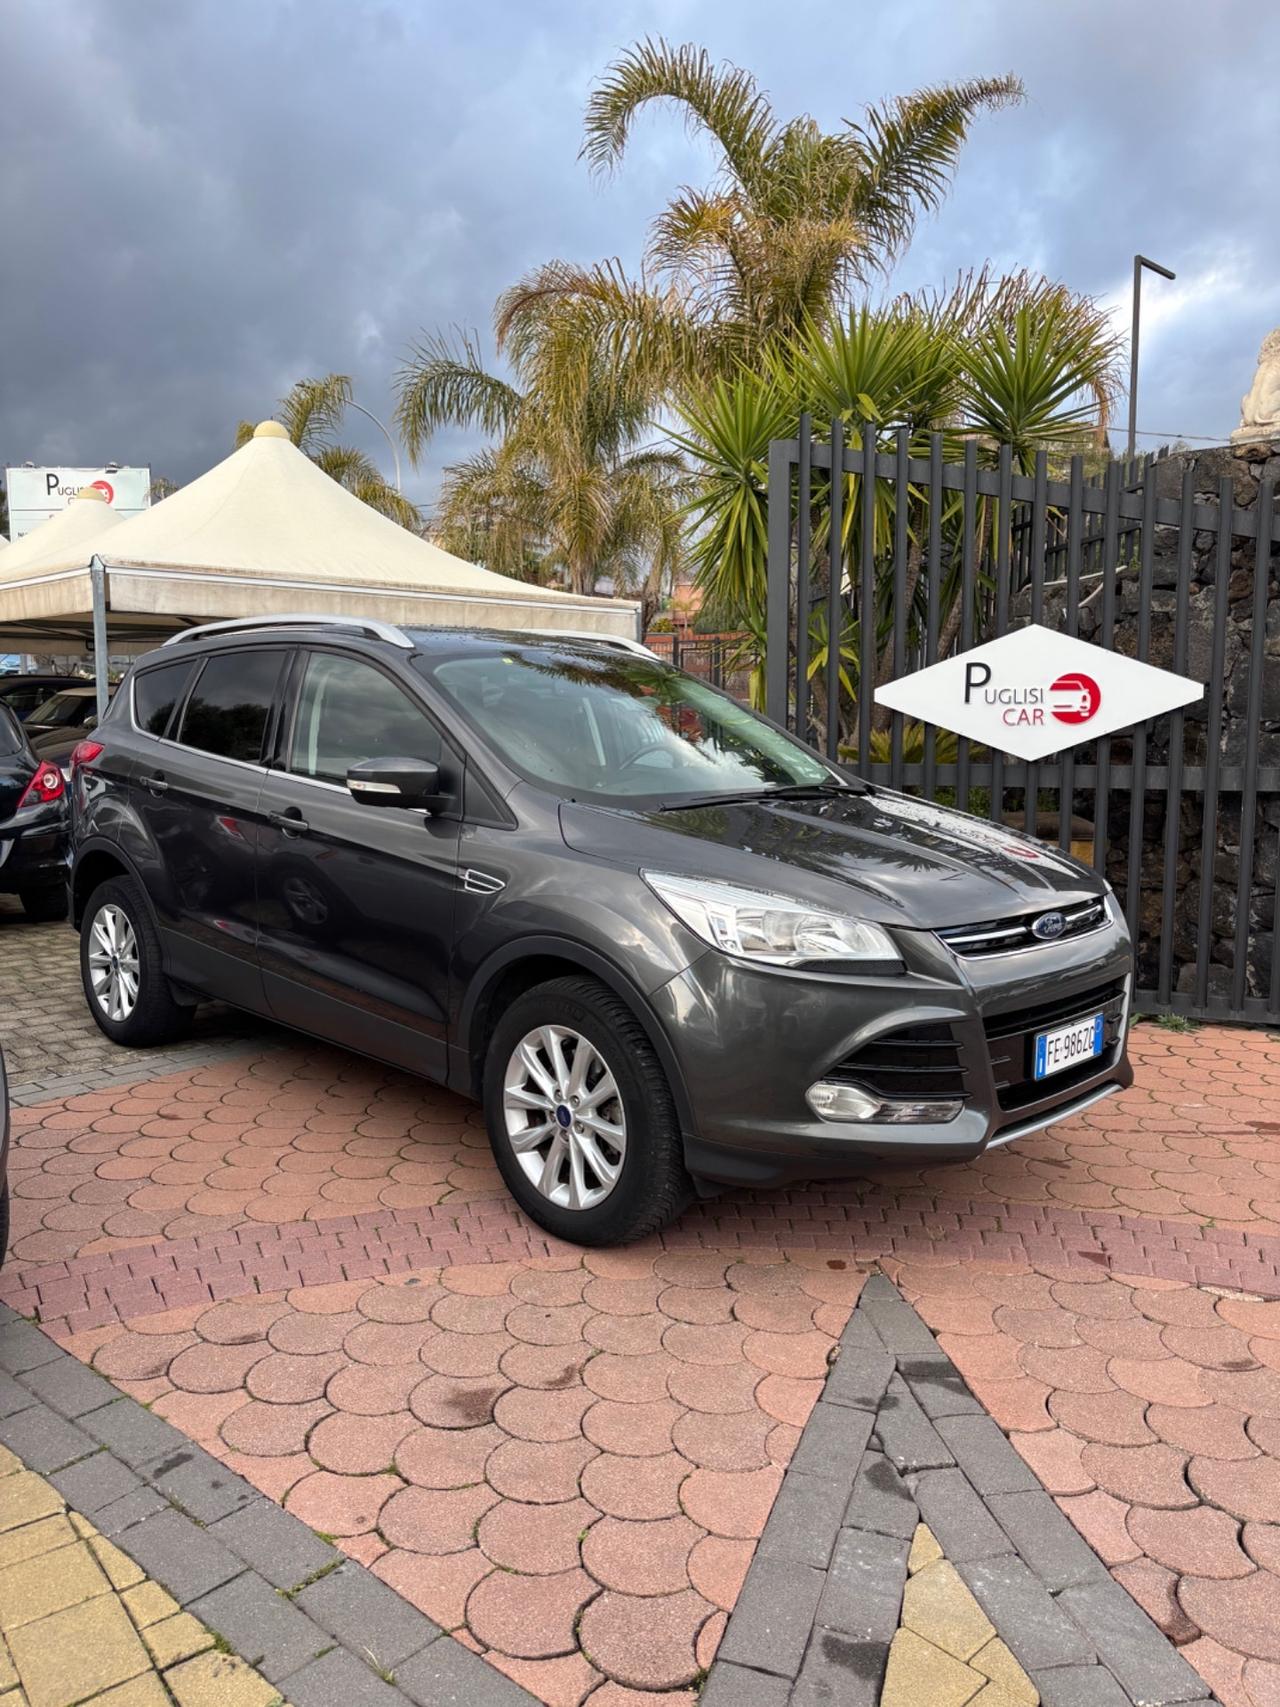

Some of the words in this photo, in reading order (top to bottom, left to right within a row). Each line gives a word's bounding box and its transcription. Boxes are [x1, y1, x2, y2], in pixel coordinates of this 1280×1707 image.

[46, 473, 83, 496] PUGLI
[966, 662, 1044, 704] PUGLISI
[1004, 709, 1044, 726] CAR
